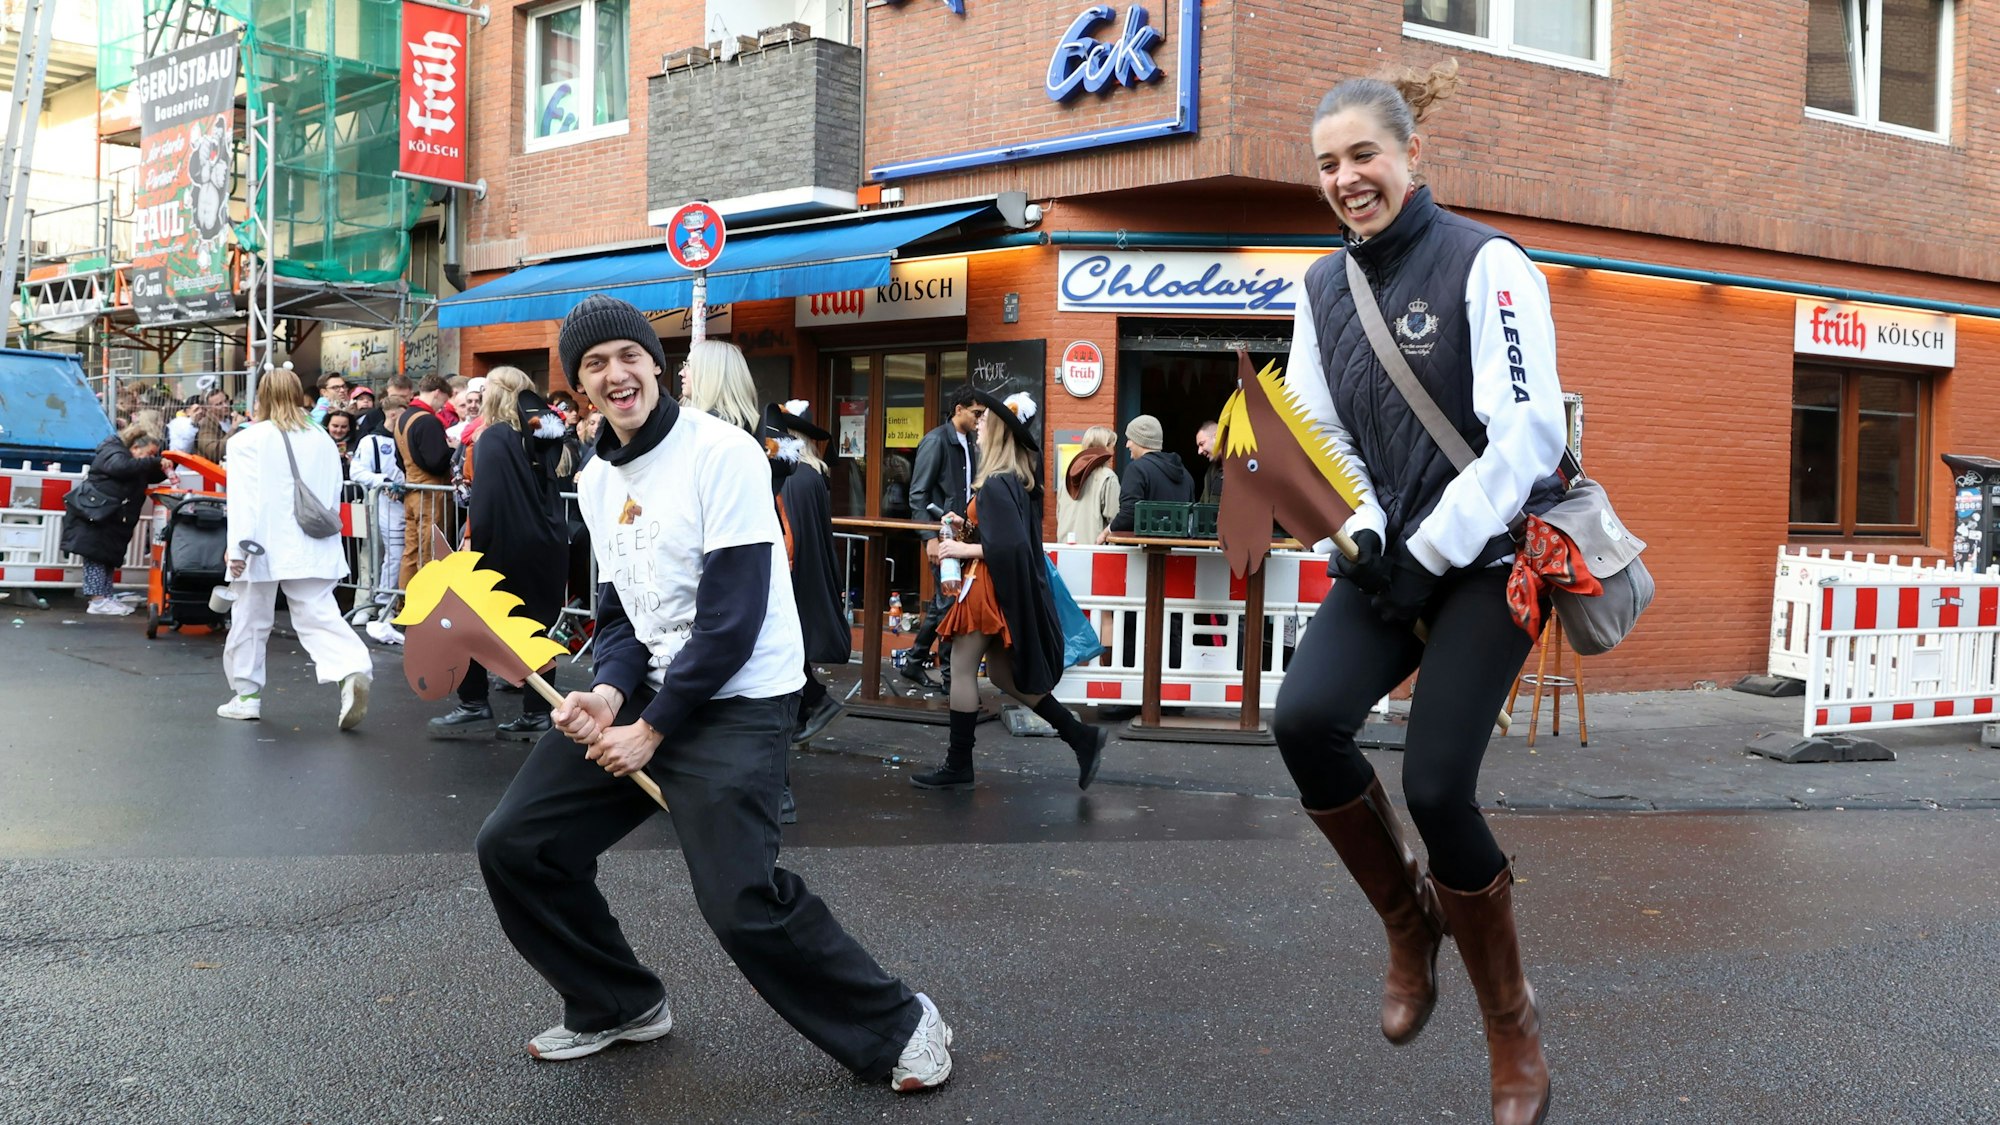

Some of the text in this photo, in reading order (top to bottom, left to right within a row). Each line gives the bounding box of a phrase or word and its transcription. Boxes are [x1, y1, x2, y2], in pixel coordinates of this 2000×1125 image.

[1045, 3, 1157, 101] Eck
[140, 46, 234, 104] GERÜSTBAU
[407, 31, 462, 136] früh
[154, 92, 210, 122] Bauservice
[408, 139, 459, 158] KÖLSCH
[136, 200, 184, 244] PAUL
[877, 277, 952, 304] KÖLSCH
[1062, 255, 1294, 310] Chlodwig
[1810, 305, 1944, 352] früh KÖLSCH
[1070, 366, 1095, 380] früh
[1500, 308, 1530, 404] LEGEA
[904, 432, 919, 440] Jahre
[608, 520, 661, 561] KEEP
[614, 560, 657, 592] CALM
